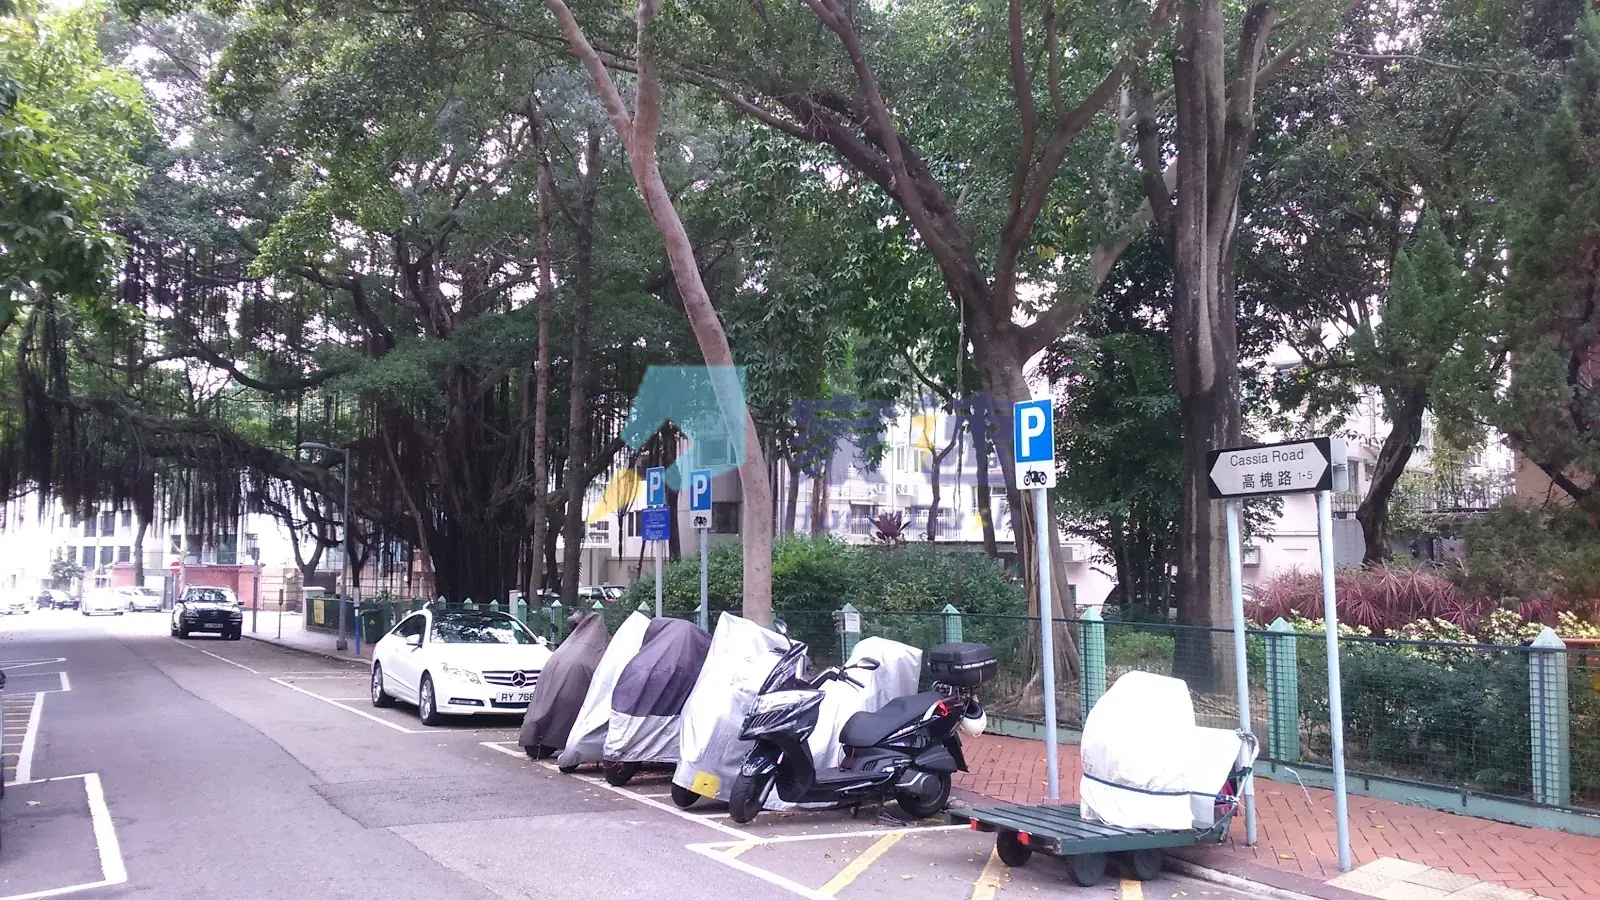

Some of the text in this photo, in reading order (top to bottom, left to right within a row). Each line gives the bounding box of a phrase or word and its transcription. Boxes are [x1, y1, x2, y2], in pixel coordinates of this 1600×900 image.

[1020, 406, 1046, 458] P
[1230, 448, 1304, 467] Cassia Road
[649, 471, 661, 502] P
[693, 474, 708, 508] P
[1242, 470, 1313, 490] 高槐路 1-5
[501, 693, 514, 701] RY
